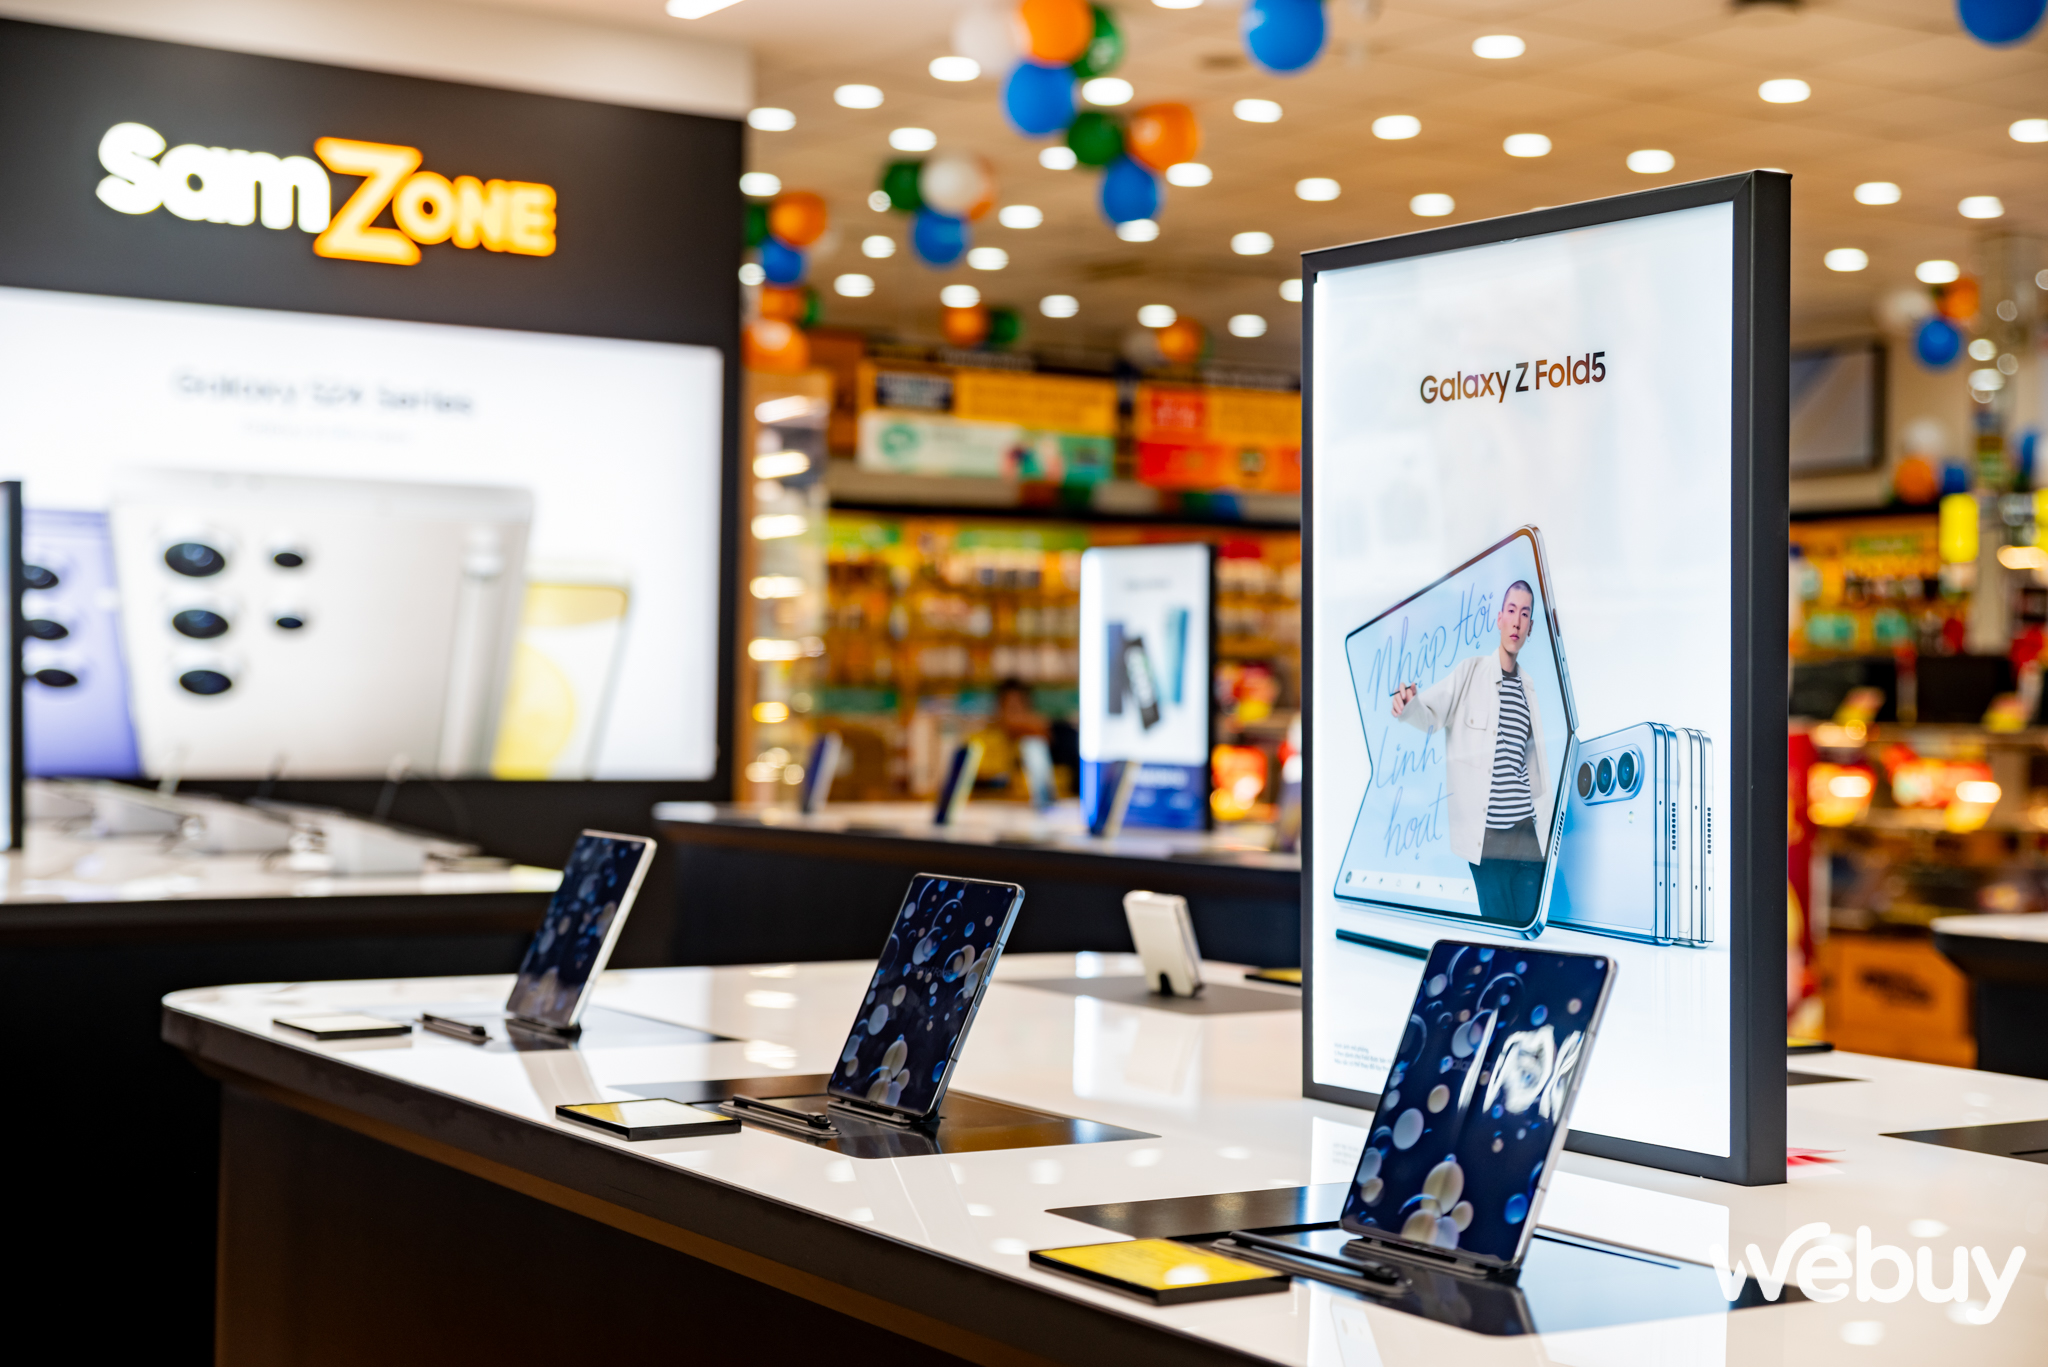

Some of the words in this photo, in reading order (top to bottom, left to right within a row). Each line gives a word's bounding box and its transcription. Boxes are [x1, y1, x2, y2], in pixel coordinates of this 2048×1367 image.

[1421, 371, 1511, 404] Galaxy
[1515, 362, 1529, 393] Z
[1535, 351, 1606, 390] Fold5
[1384, 782, 1454, 861] hoạt
